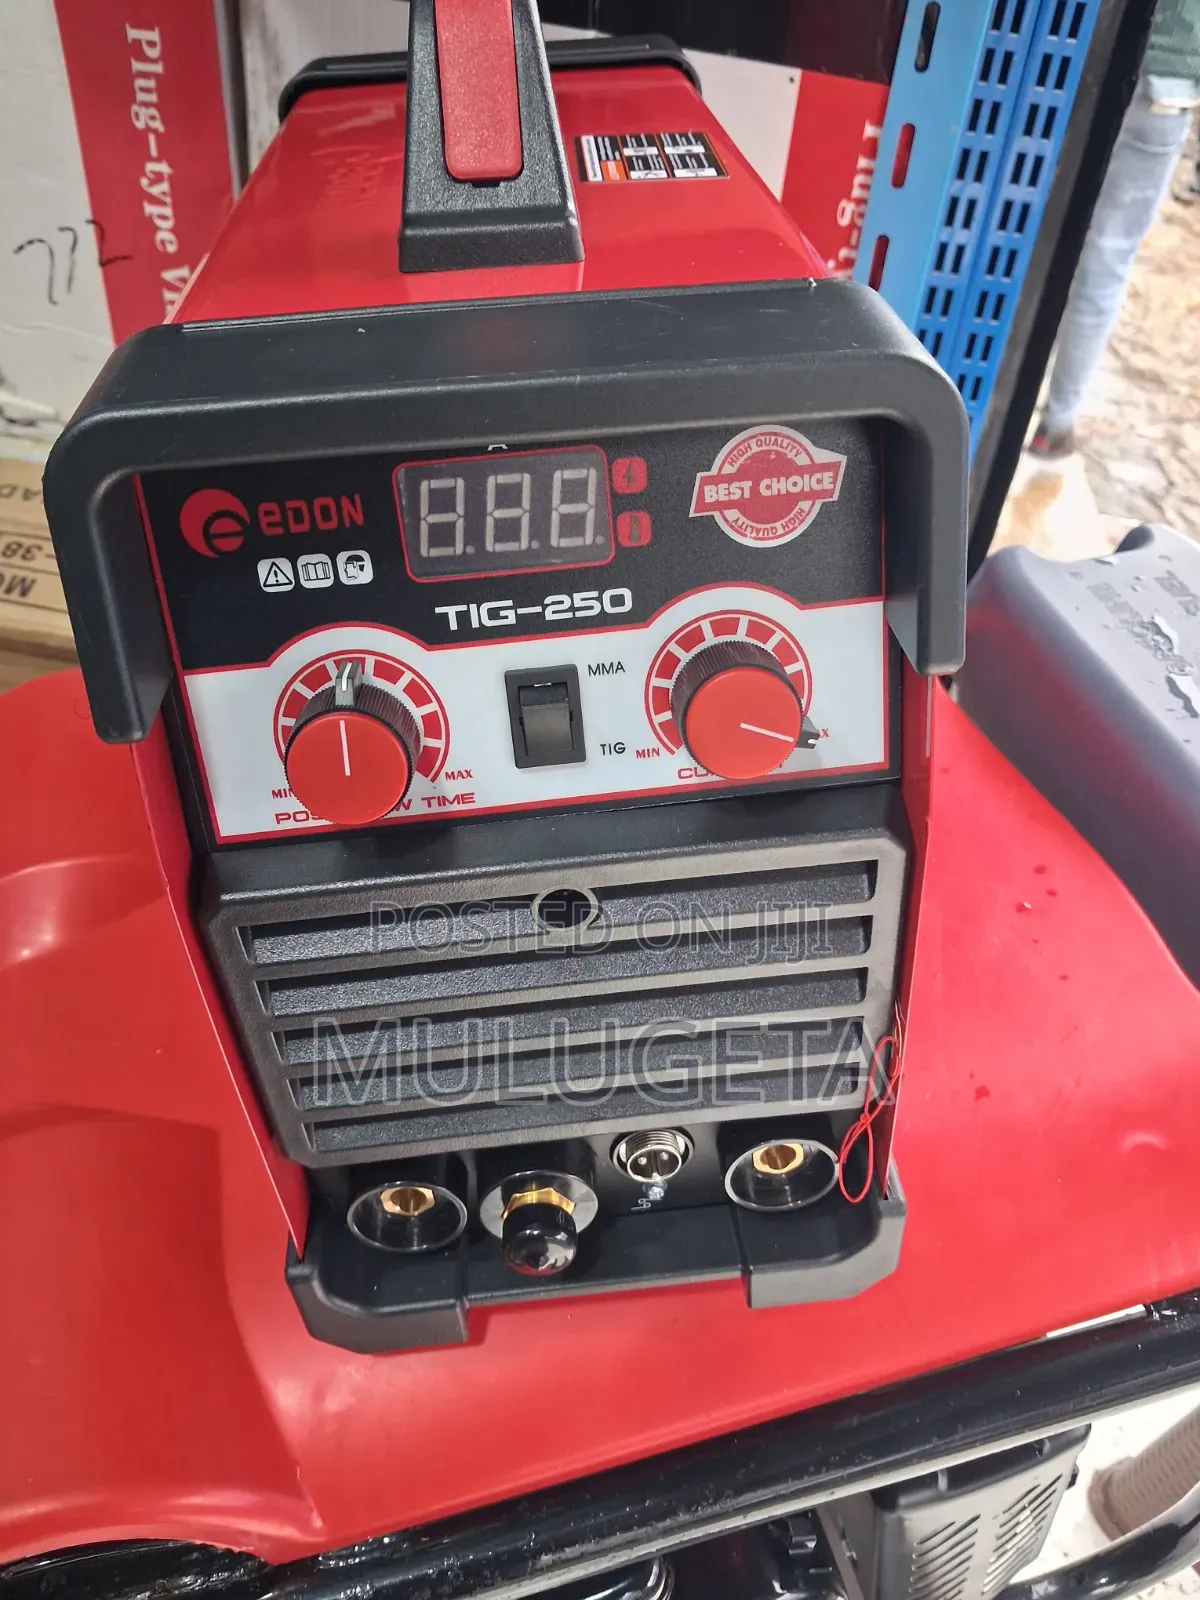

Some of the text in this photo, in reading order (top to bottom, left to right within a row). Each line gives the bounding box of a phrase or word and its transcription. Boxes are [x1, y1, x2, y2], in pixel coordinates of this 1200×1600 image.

[125, 22, 179, 254] Plug-type
[727, 437, 803, 468] HIGH QUALITY
[704, 471, 834, 503] BEST CHOICE
[733, 506, 806, 537] HIGH QUALITY
[435, 587, 633, 631] TIG-250
[587, 660, 626, 677] MMA
[600, 741, 626, 756] TIG
[635, 747, 660, 759] MIN
[445, 769, 473, 781] MAX
[421, 792, 476, 808] TIME
